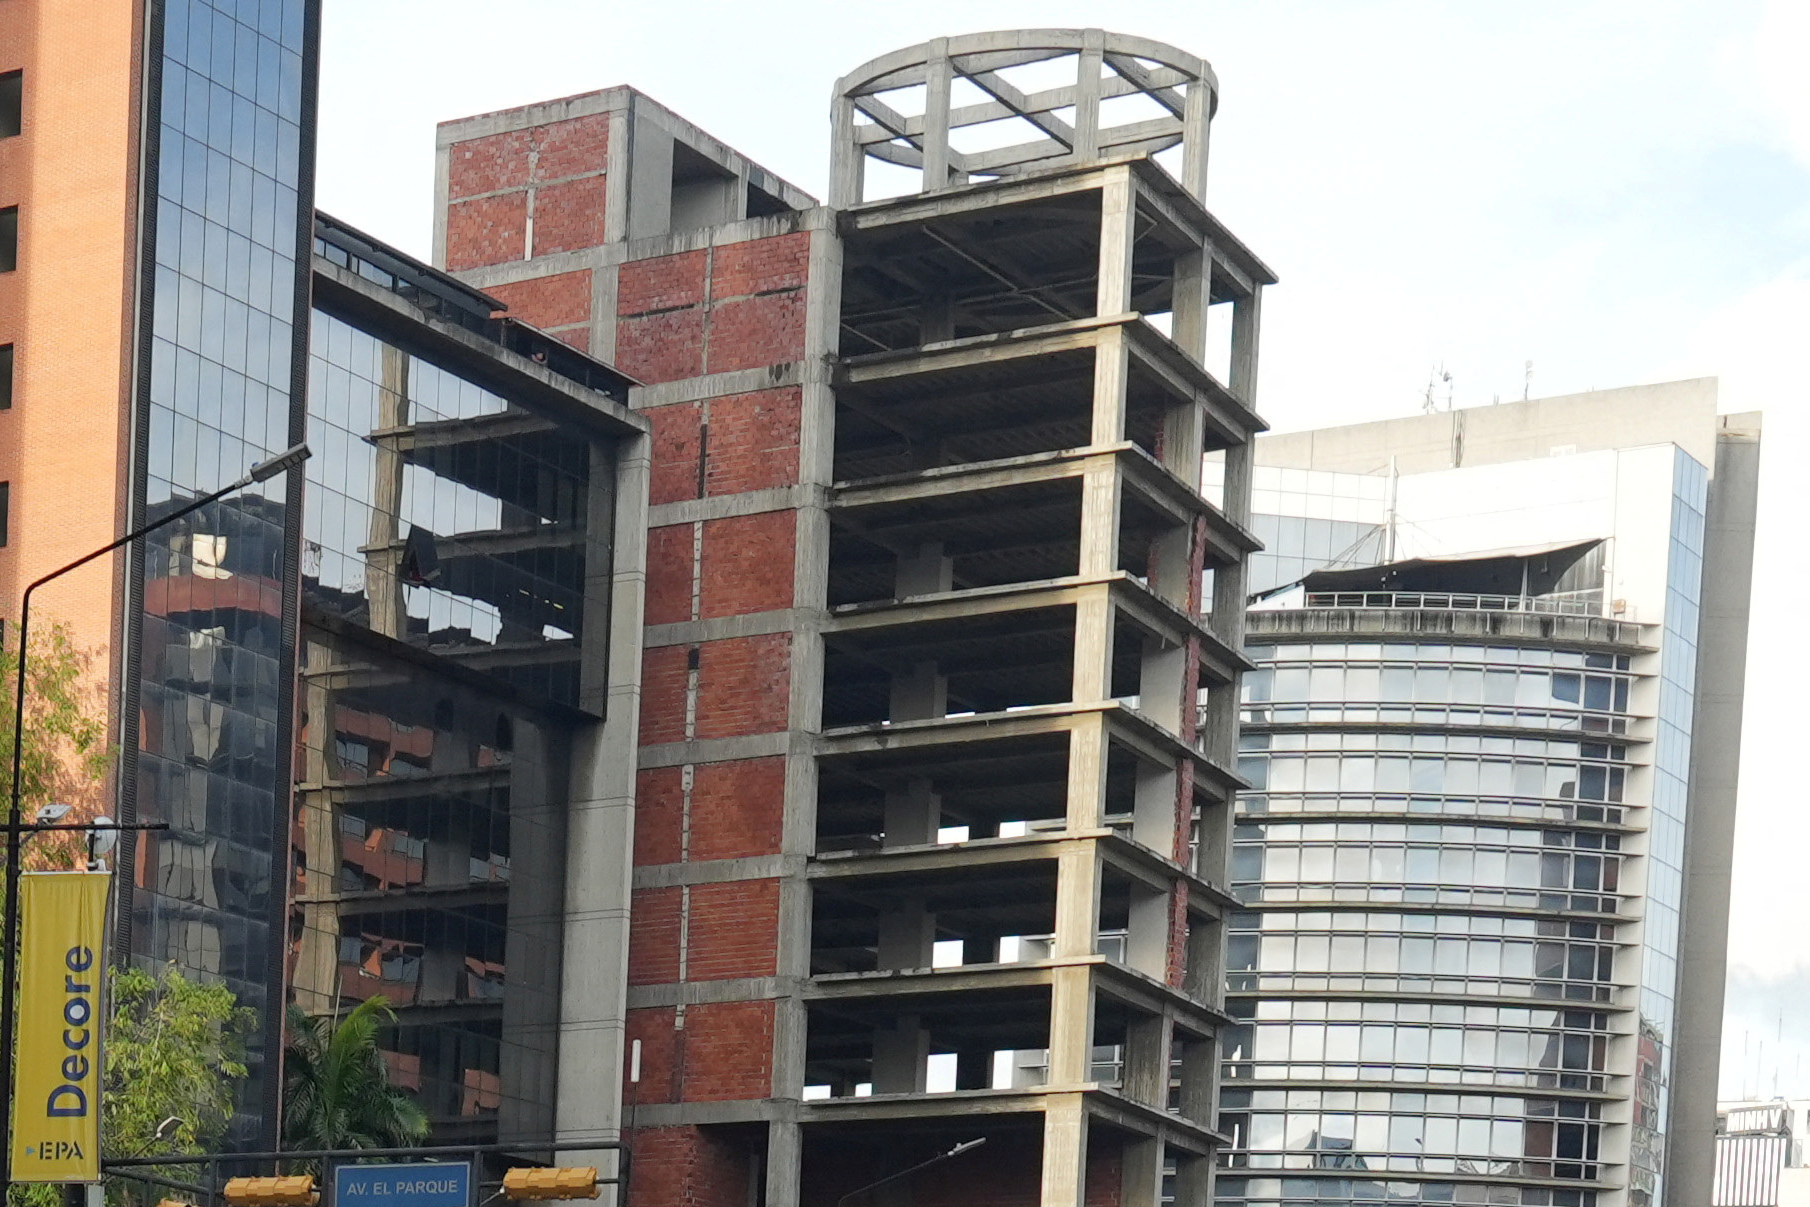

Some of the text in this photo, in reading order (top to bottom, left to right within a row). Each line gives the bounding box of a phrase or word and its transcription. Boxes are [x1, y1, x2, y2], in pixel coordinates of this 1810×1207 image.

[47, 945, 93, 1117] Decore
[39, 1141, 84, 1160] EPA
[347, 1180, 458, 1195] AV. EL PARQUE
